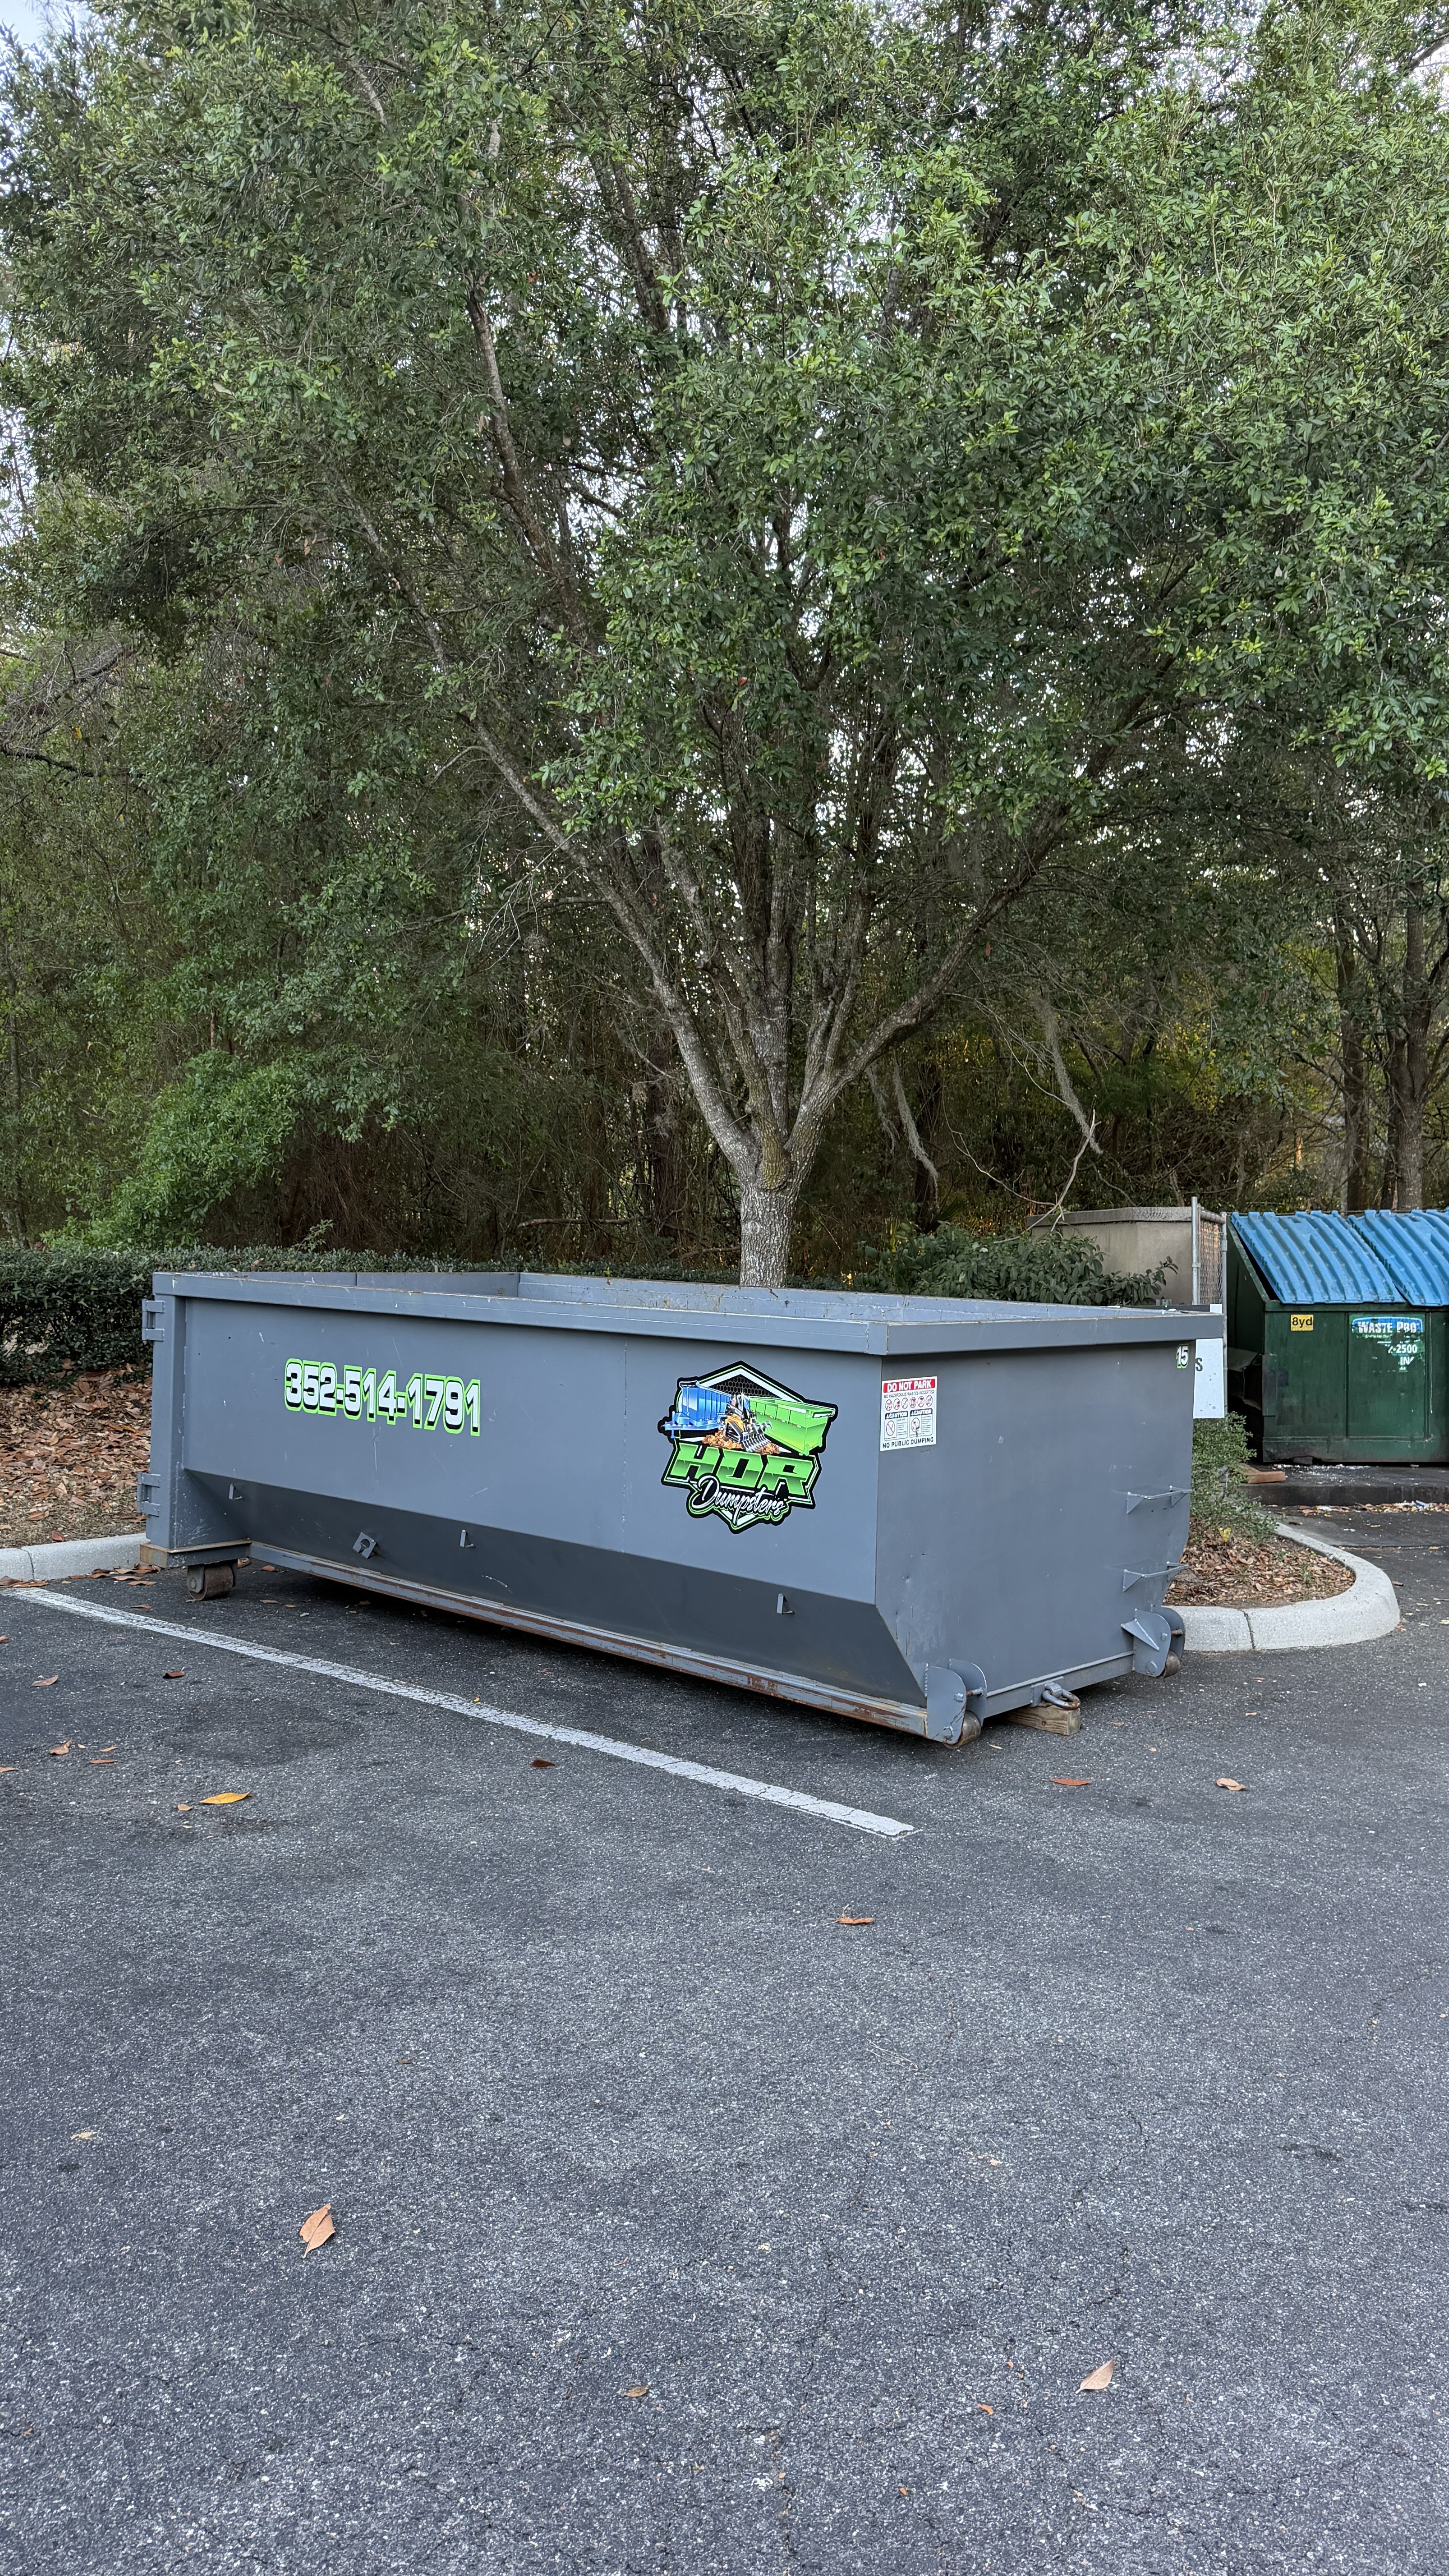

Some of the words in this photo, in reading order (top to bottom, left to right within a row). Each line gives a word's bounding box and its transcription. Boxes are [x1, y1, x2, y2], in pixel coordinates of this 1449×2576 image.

[1292, 1316, 1312, 1328] 8yd
[1357, 1321, 1393, 1333] WASTE
[1176, 1345, 1188, 1368] 15
[887, 1382, 897, 1392] DO
[899, 1381, 912, 1391] NOT
[914, 1380, 932, 1389] PARK
[285, 1358, 481, 1436] 352-514-1791
[911, 1437, 934, 1445] DUMPING
[691, 1475, 786, 1525] Dumpsters
